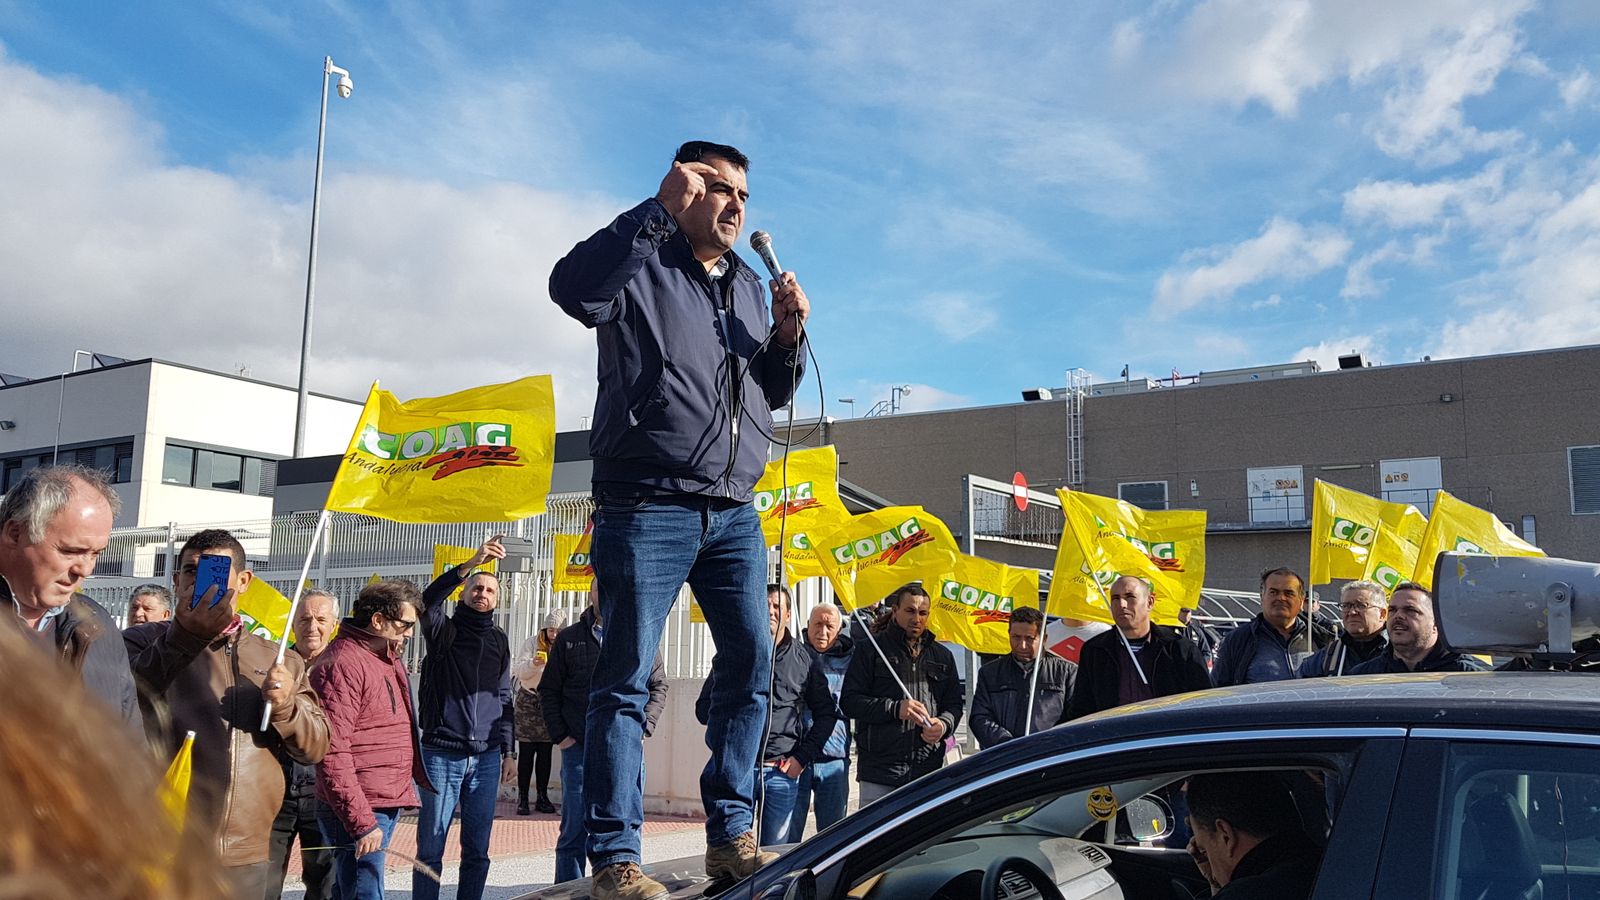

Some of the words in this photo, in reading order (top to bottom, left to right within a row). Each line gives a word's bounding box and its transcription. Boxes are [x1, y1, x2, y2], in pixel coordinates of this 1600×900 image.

[361, 424, 506, 459] COAG
[753, 482, 811, 512] OAG
[834, 518, 920, 564] COAG
[1333, 519, 1375, 546] CO
[943, 581, 1012, 613] COAG
